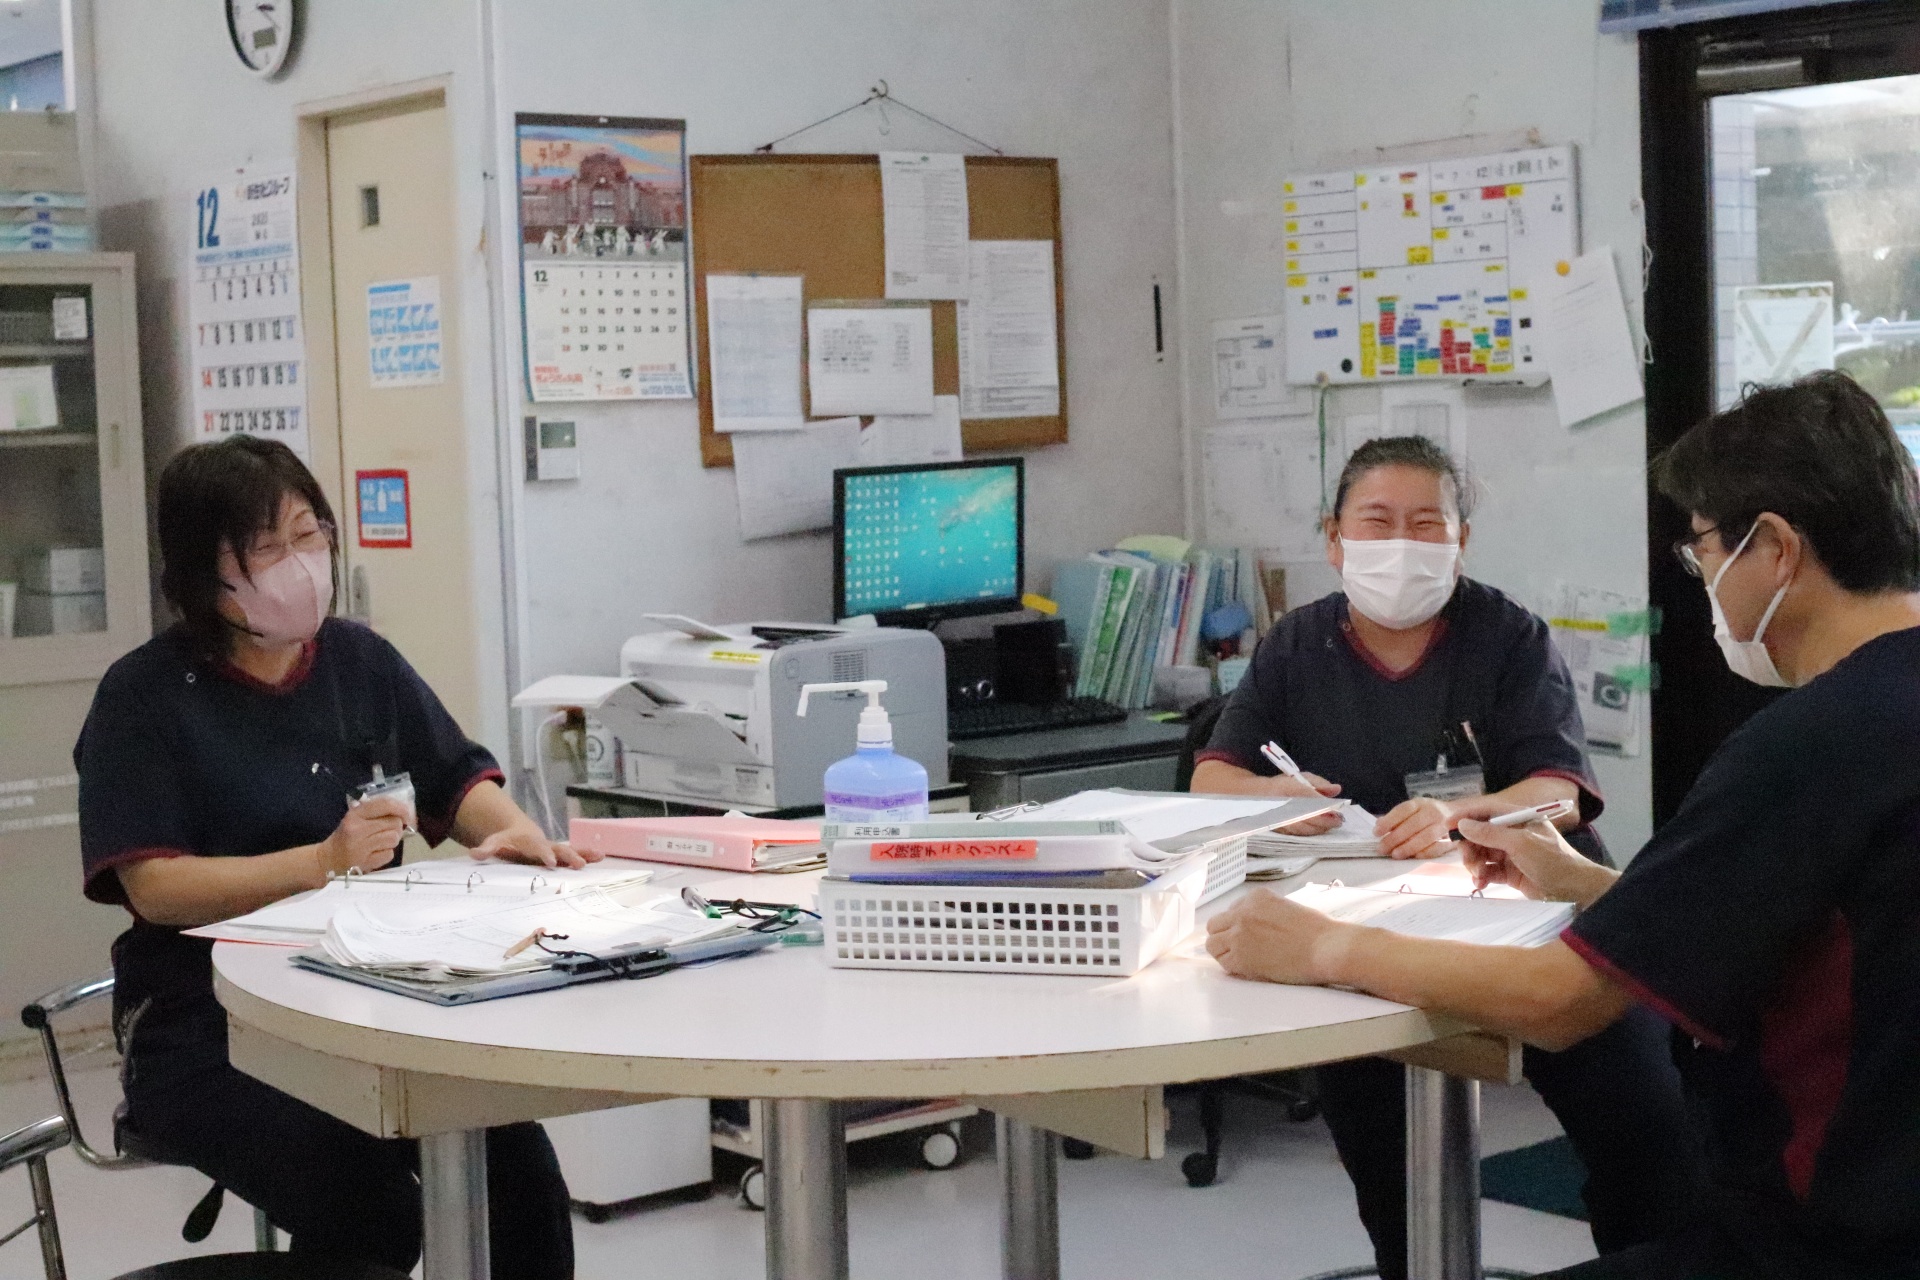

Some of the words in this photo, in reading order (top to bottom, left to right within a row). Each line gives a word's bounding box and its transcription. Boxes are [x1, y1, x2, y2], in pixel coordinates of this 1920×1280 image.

[197, 187, 220, 249] 12
[533, 270, 549, 282] 12
[580, 307, 588, 315] 15
[598, 307, 606, 315] 16
[615, 307, 624, 315] 17
[633, 307, 642, 315] 18
[651, 307, 659, 315] 19
[668, 307, 677, 315] 20
[198, 323, 206, 346] 7
[215, 323, 221, 345] 8
[229, 321, 236, 344] 9
[244, 321, 254, 343] 10
[258, 321, 267, 342] 11
[273, 319, 281, 341] 12
[579, 325, 588, 334] 22
[598, 325, 607, 334] 23
[615, 325, 625, 334] 24
[633, 325, 642, 334] 25
[651, 325, 660, 334] 26
[668, 325, 677, 334] 27
[580, 344, 589, 352] 29
[598, 344, 607, 352] 30
[617, 344, 625, 352] 31
[202, 368, 213, 388] 14
[218, 366, 227, 388] 15
[232, 366, 241, 388] 16
[246, 365, 255, 387] 17
[260, 364, 270, 386] 18
[275, 363, 284, 385] 19
[204, 410, 214, 433] 21
[220, 411, 230, 432] 22
[234, 410, 245, 432] 23
[248, 409, 258, 431] 24
[262, 409, 272, 431] 25
[276, 408, 286, 430] 26
[853, 825, 901, 837] 利用申込書
